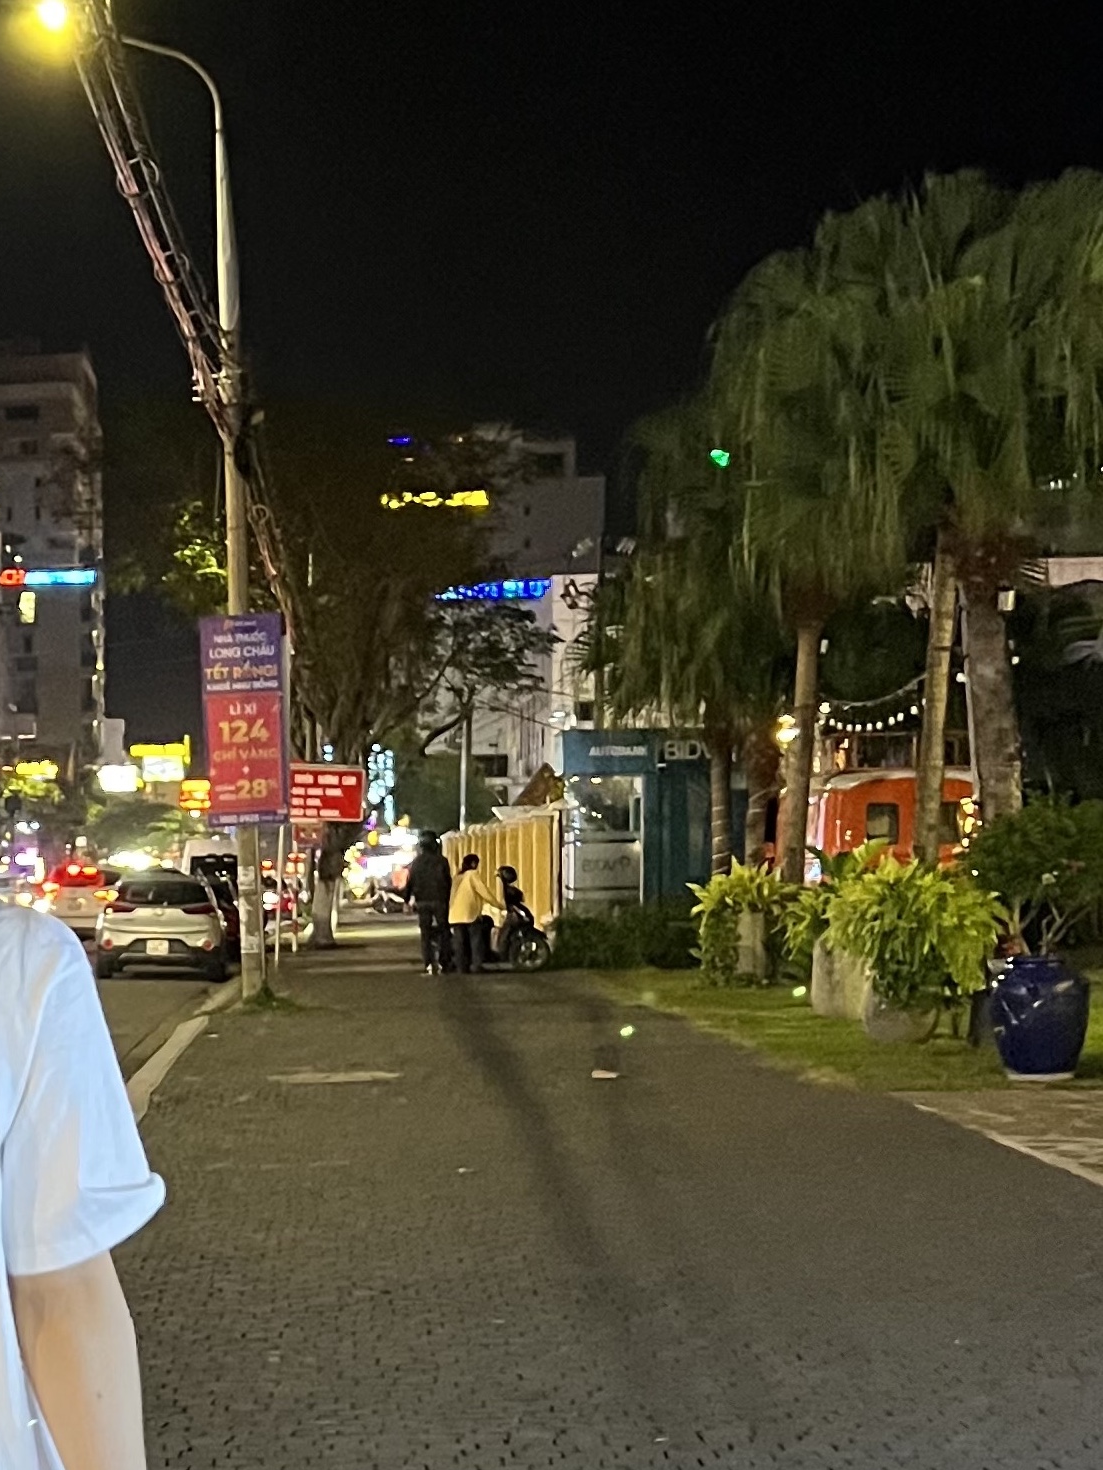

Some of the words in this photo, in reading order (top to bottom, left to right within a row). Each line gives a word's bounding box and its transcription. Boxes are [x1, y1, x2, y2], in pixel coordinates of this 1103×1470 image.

[209, 646, 241, 659] LONG
[204, 662, 229, 680] TẾT
[219, 718, 271, 744] 124
